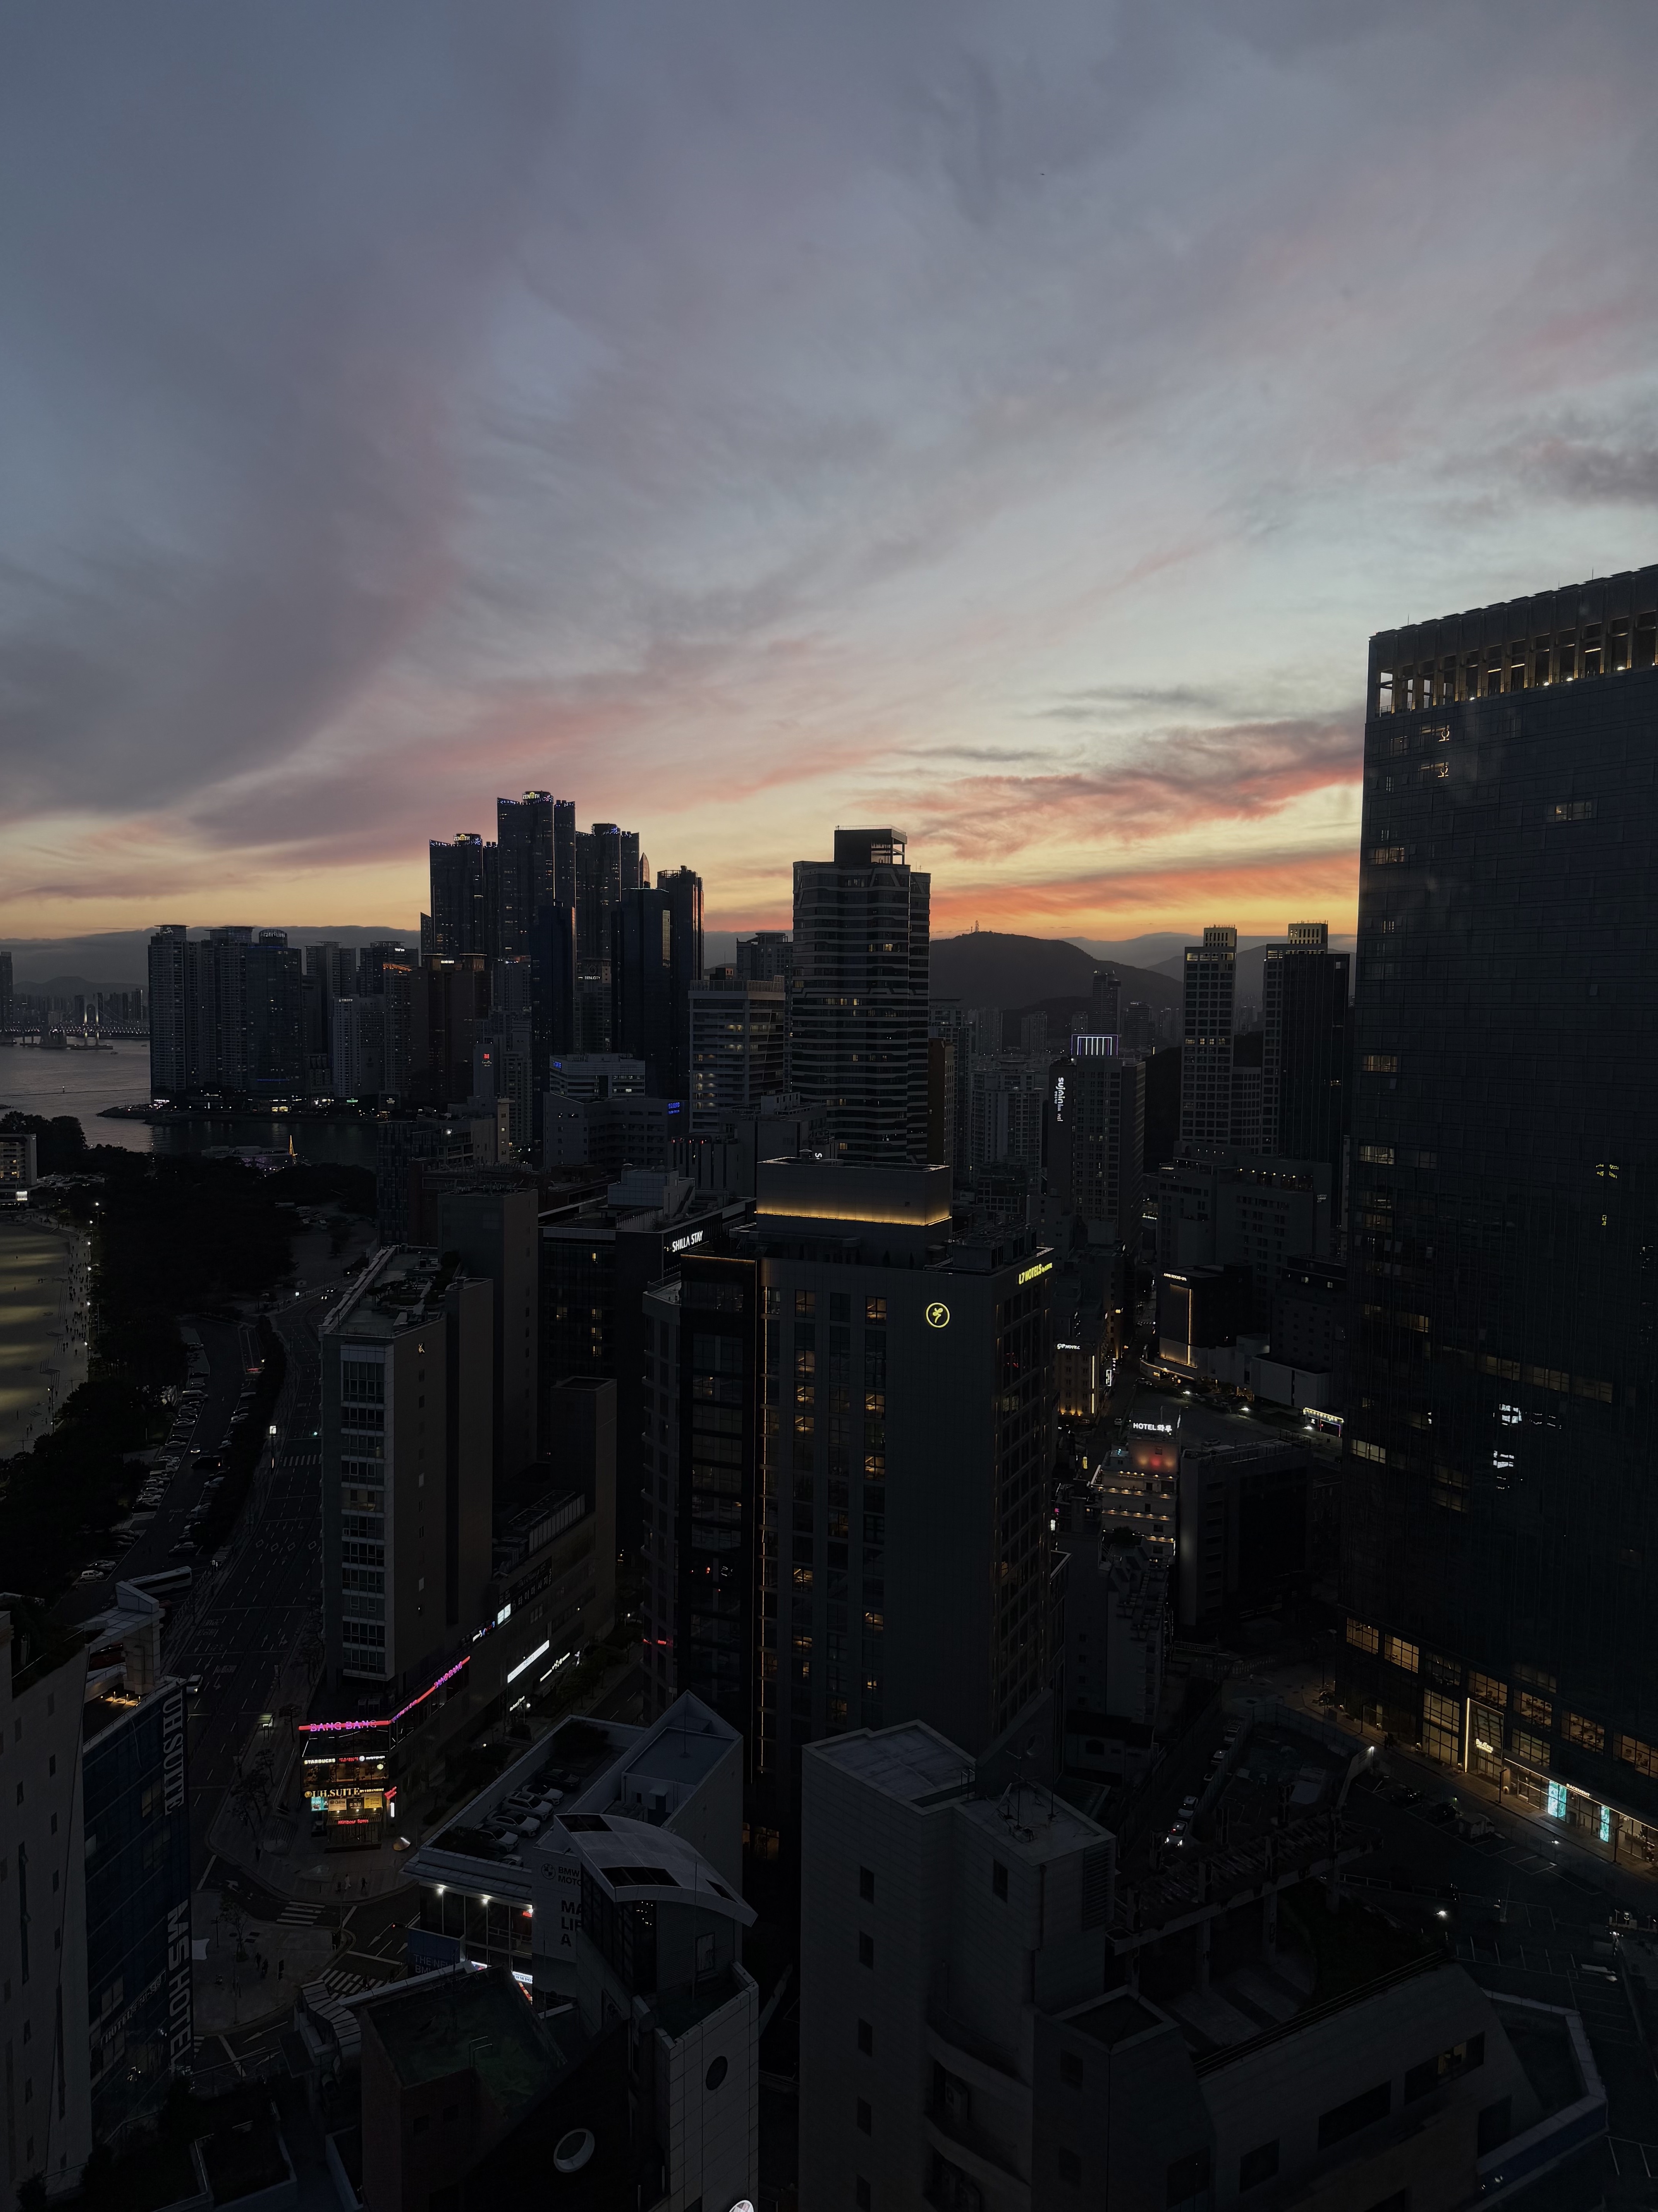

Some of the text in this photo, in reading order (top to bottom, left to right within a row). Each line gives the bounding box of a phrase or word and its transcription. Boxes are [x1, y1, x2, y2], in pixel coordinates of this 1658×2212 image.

[672, 1230, 703, 1252] SHILLA STAY
[1019, 1272, 1025, 1285] L7
[1025, 1264, 1042, 1281] HOTELS
[1133, 1422, 1156, 1431] HOTEL
[310, 1720, 376, 1732] BANG BANG
[163, 1690, 184, 1816] UH SUITE
[558, 1867, 580, 1877] BMW
[561, 1933, 572, 1947] A
[414, 1954, 431, 1966] THE
[415, 1965, 431, 1974] BM
[168, 1898, 192, 2073] MS HOTEL
